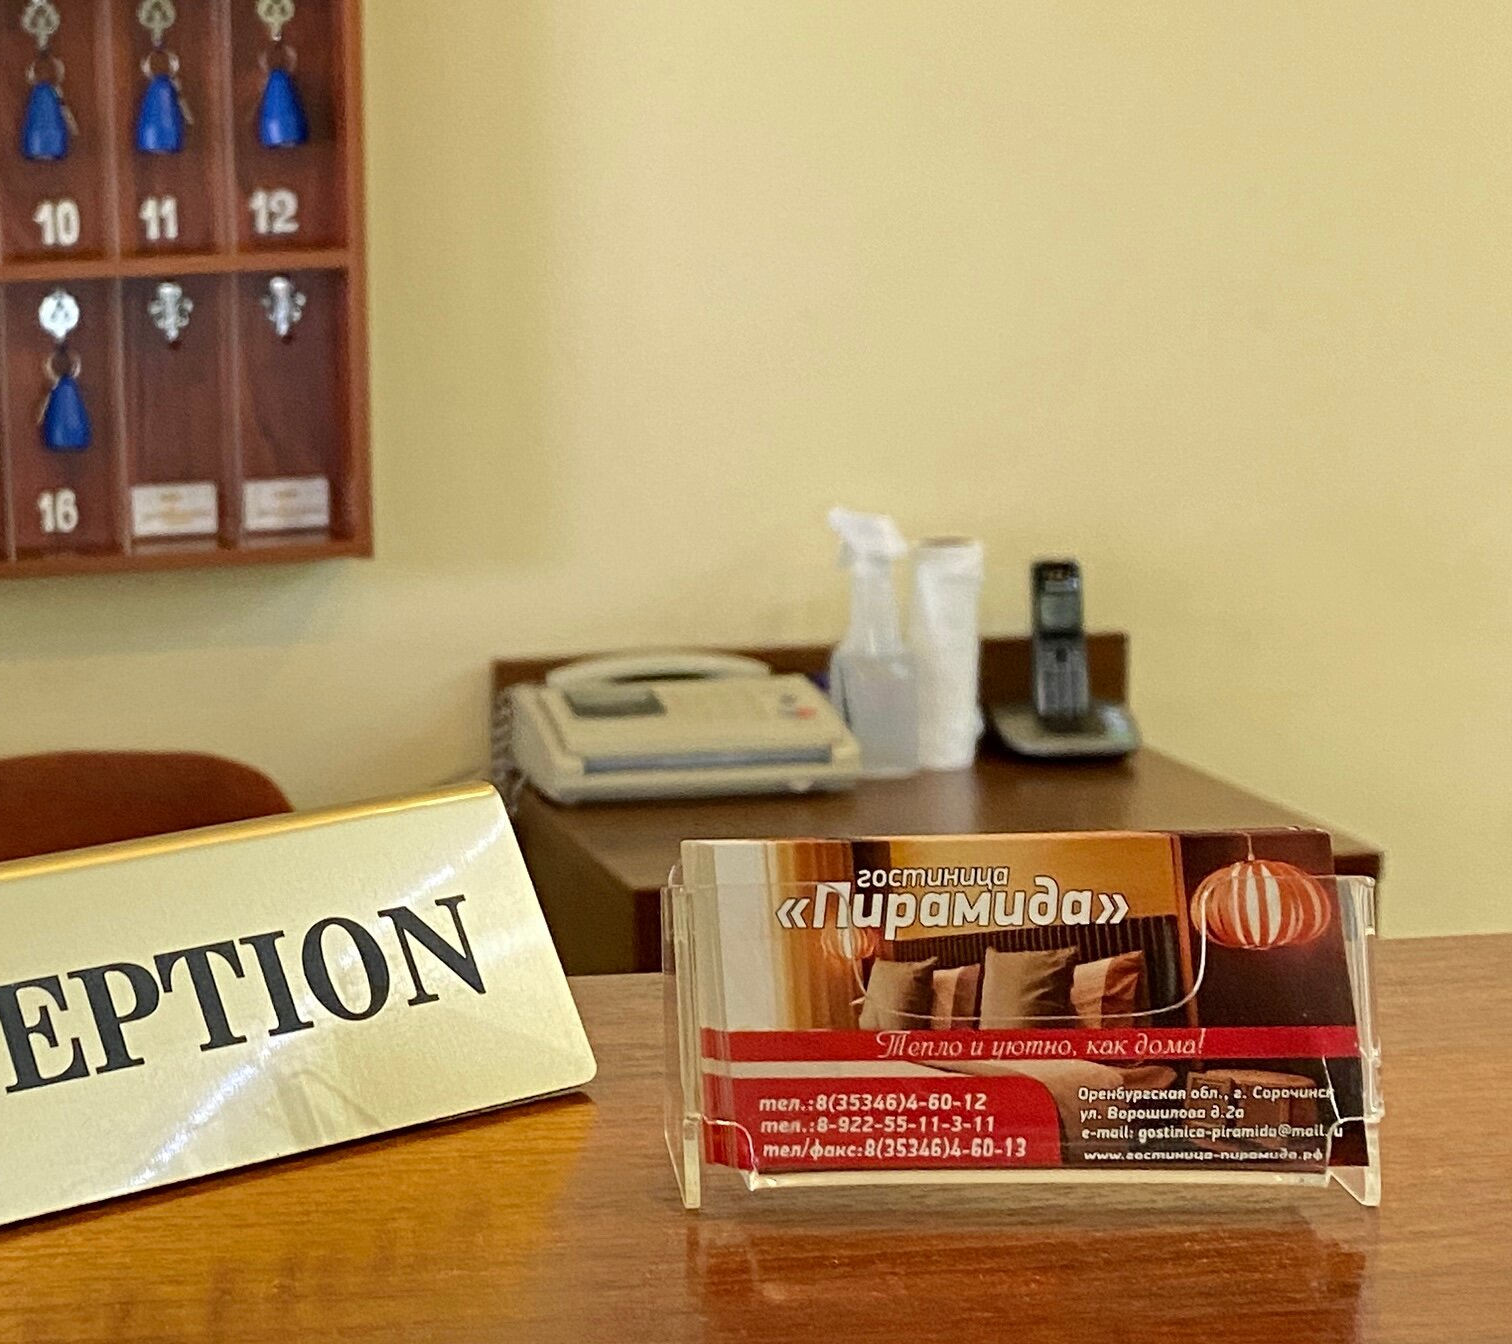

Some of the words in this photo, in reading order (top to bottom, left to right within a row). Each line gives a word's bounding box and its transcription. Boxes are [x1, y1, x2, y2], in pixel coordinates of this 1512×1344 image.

[34, 199, 81, 246] 10
[140, 195, 180, 242] 11
[249, 188, 300, 235] 12
[37, 489, 80, 534] 16
[857, 866, 1010, 891] гостиница
[774, 875, 1131, 941] «Пирамида»
[876, 1030, 963, 1058] Тепло
[970, 1040, 986, 1056] и
[991, 1039, 1078, 1060] уютно,
[1086, 1037, 1129, 1055] как
[1134, 1027, 1207, 1055] дома!
[759, 1093, 988, 1113] тел.:8(35346)4-60-12
[1078, 1087, 1187, 1103] Оренбургская
[1191, 1086, 1229, 1103] обл.,
[1233, 1089, 1248, 1100] г.
[760, 1115, 996, 1134] тел.:8-922-55-11-3-11
[1080, 1108, 1102, 1121] ул.
[1107, 1106, 1207, 1120] Ворошилова
[1210, 1104, 1245, 1120] д.2а
[1081, 1125, 1135, 1140] e-mail:
[1138, 1124, 1344, 1144] gostinica-piramida@mail.u
[763, 1136, 1028, 1160] тел/факс:8(35346)4-60-13
